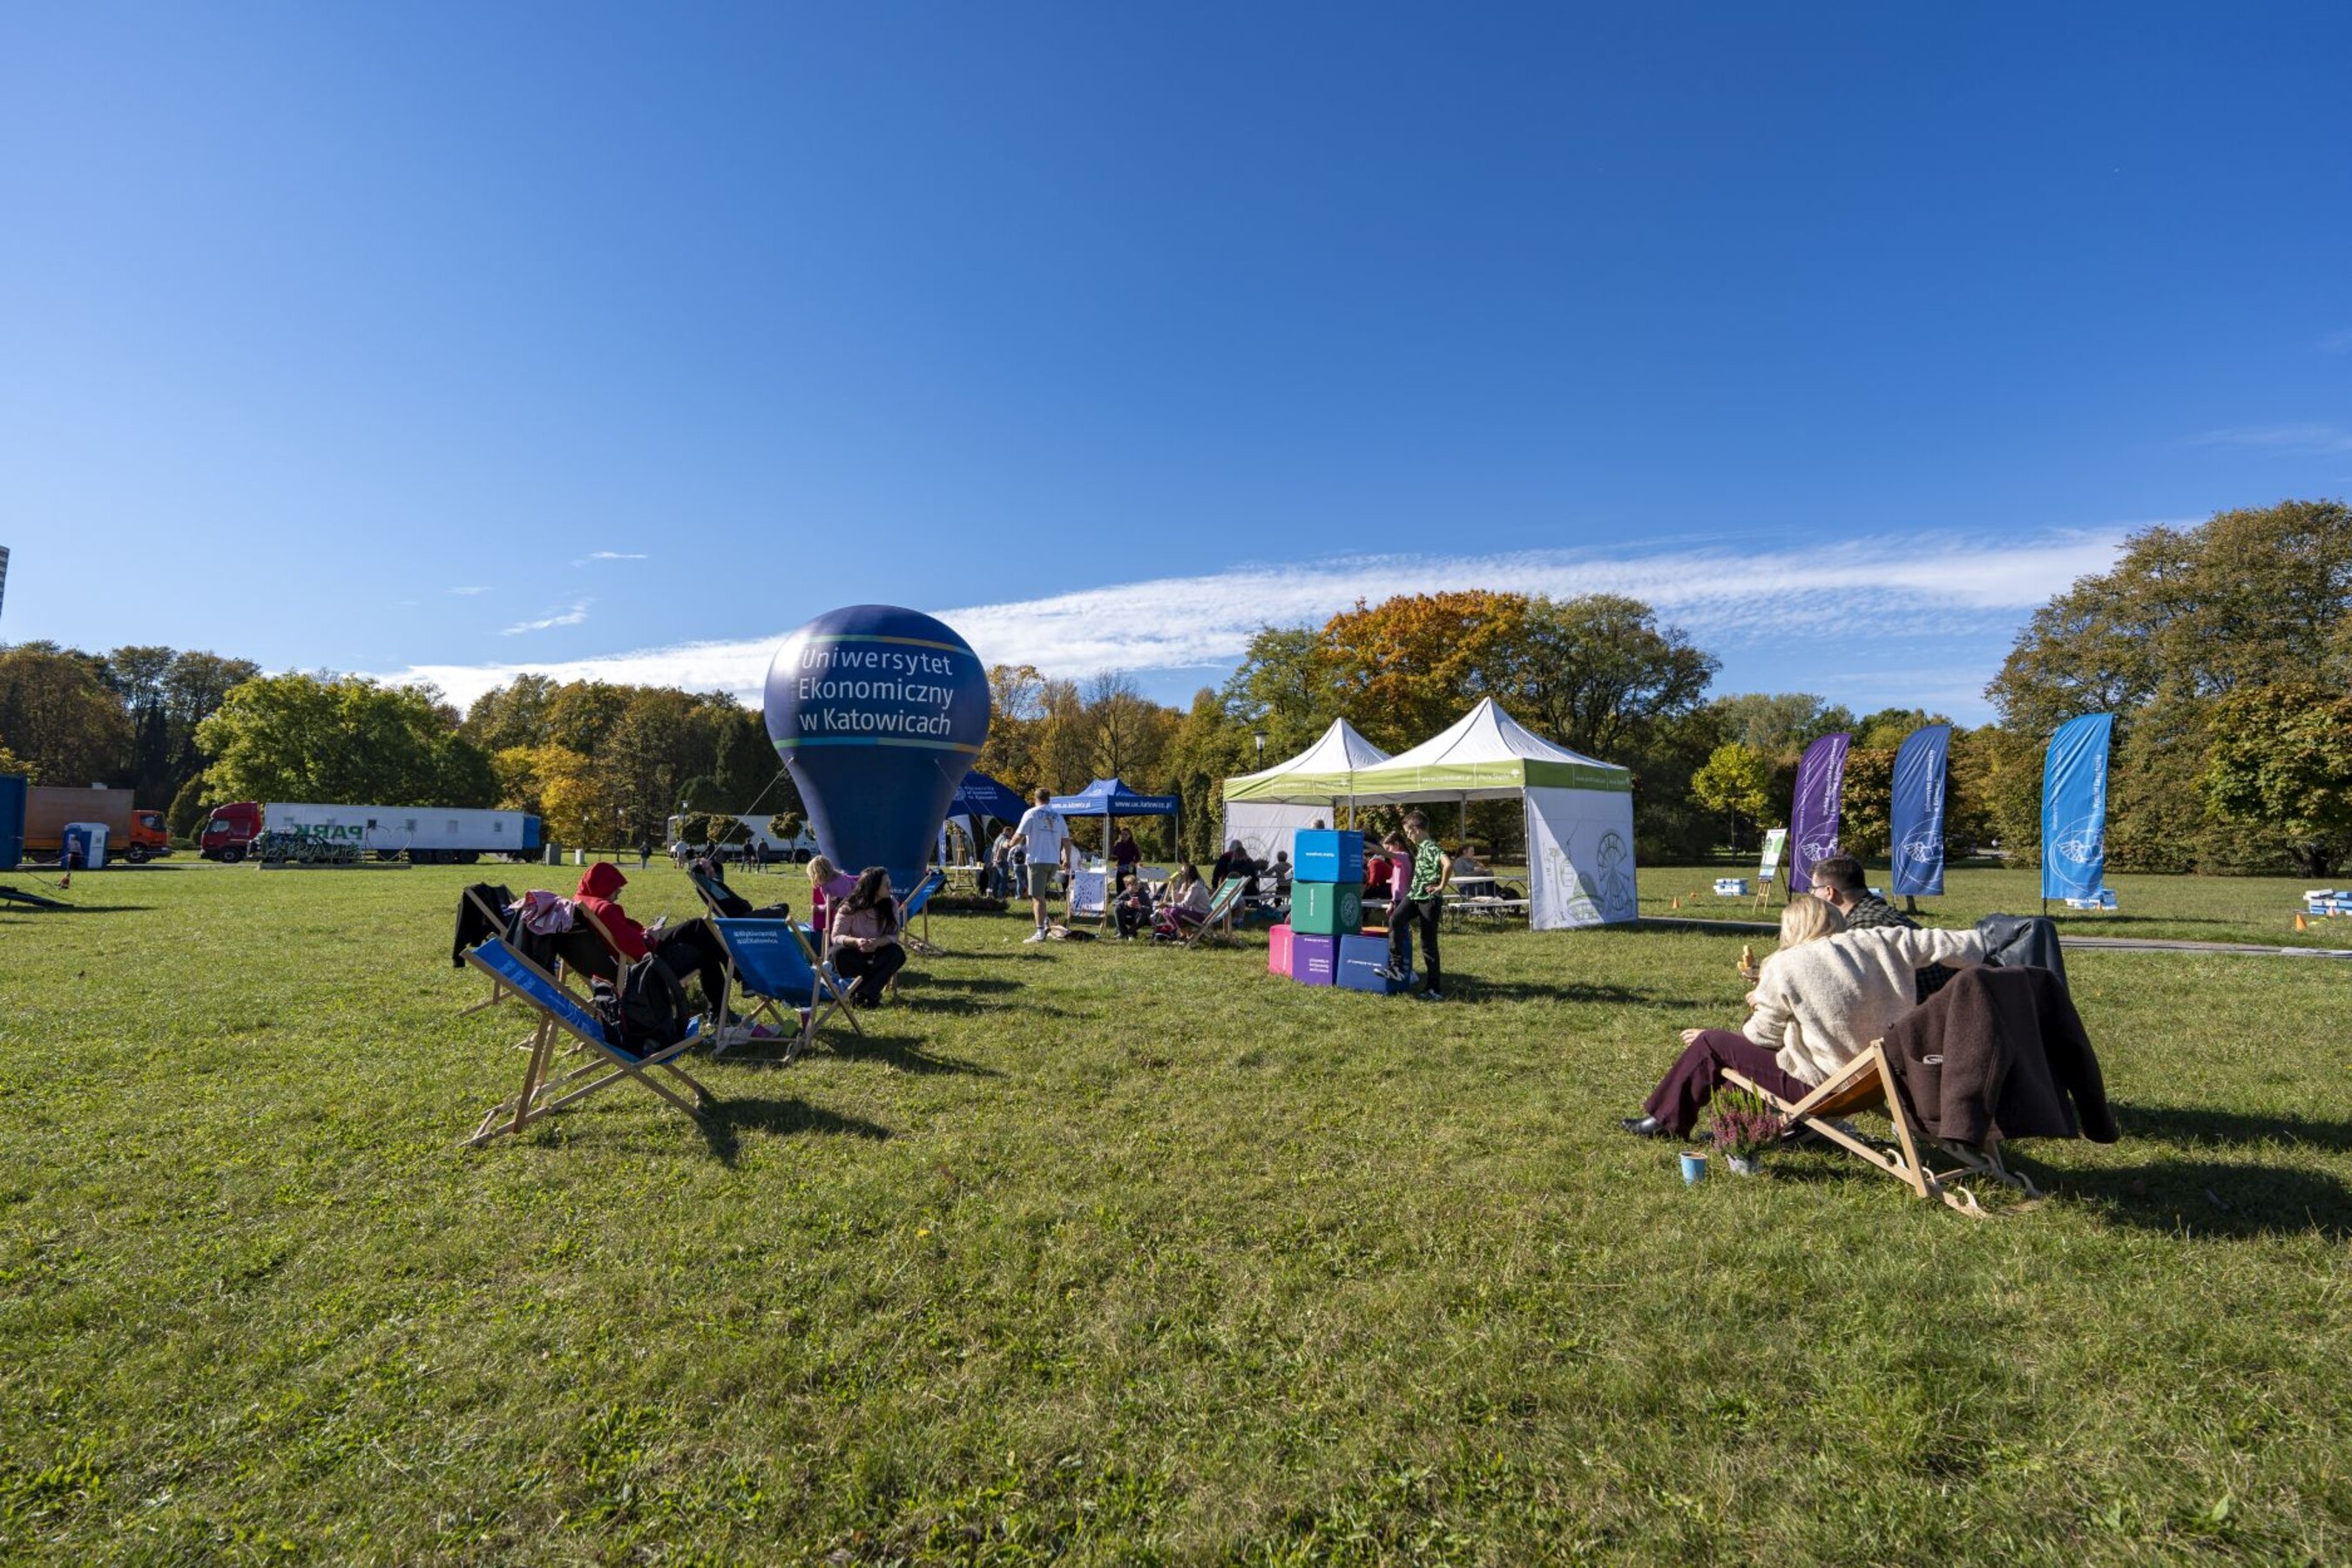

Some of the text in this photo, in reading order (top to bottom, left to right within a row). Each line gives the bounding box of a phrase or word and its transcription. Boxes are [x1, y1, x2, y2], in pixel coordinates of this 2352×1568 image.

[801, 646, 953, 676] Uniwersytet
[798, 677, 954, 711] Ekonomiczny
[799, 707, 951, 735] w Katowicach
